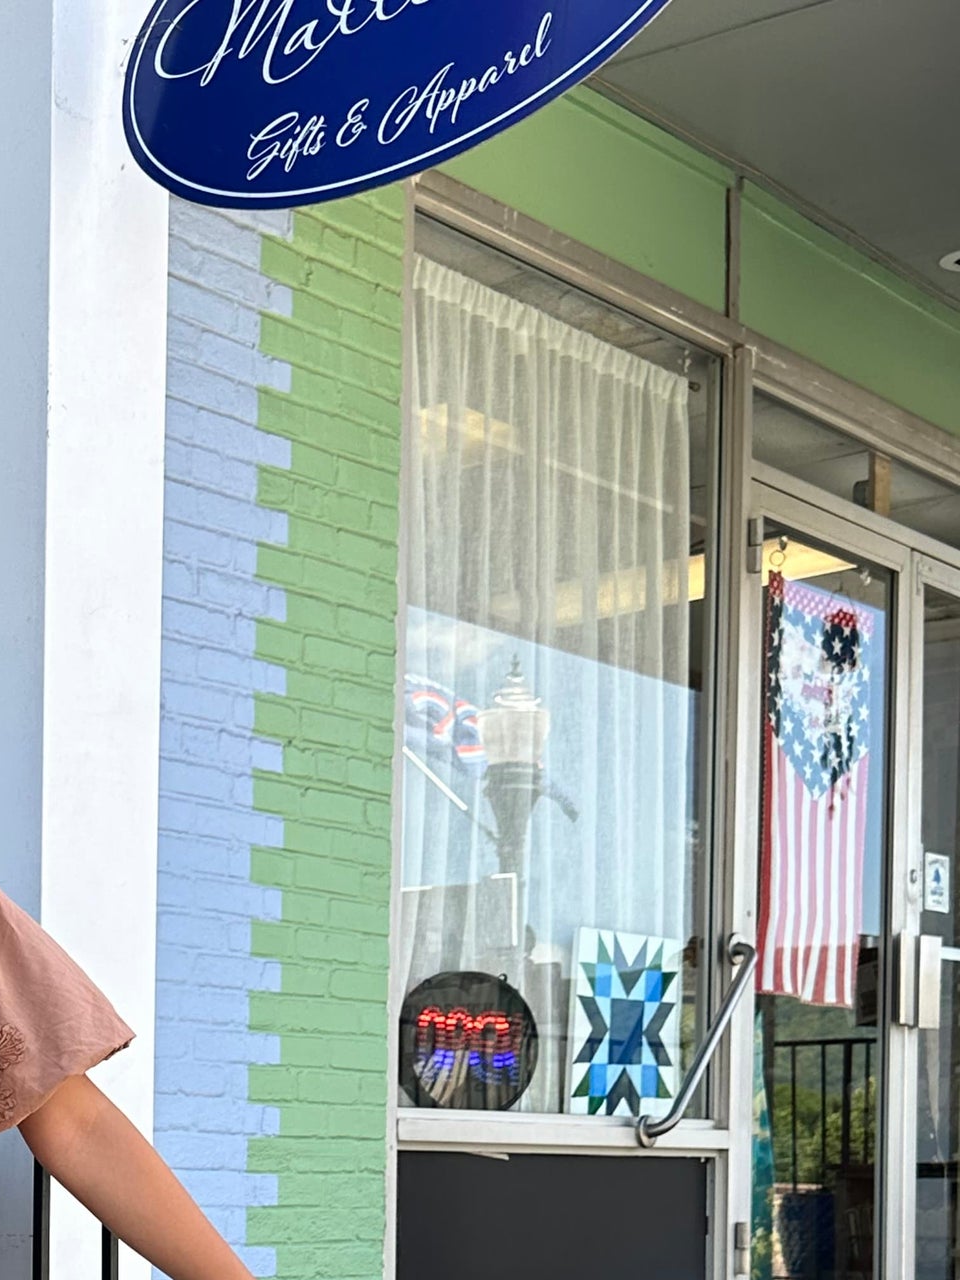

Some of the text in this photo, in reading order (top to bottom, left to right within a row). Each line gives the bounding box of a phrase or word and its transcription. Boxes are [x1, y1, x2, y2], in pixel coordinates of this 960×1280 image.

[246, 12, 553, 181] Gifts & Apparel
